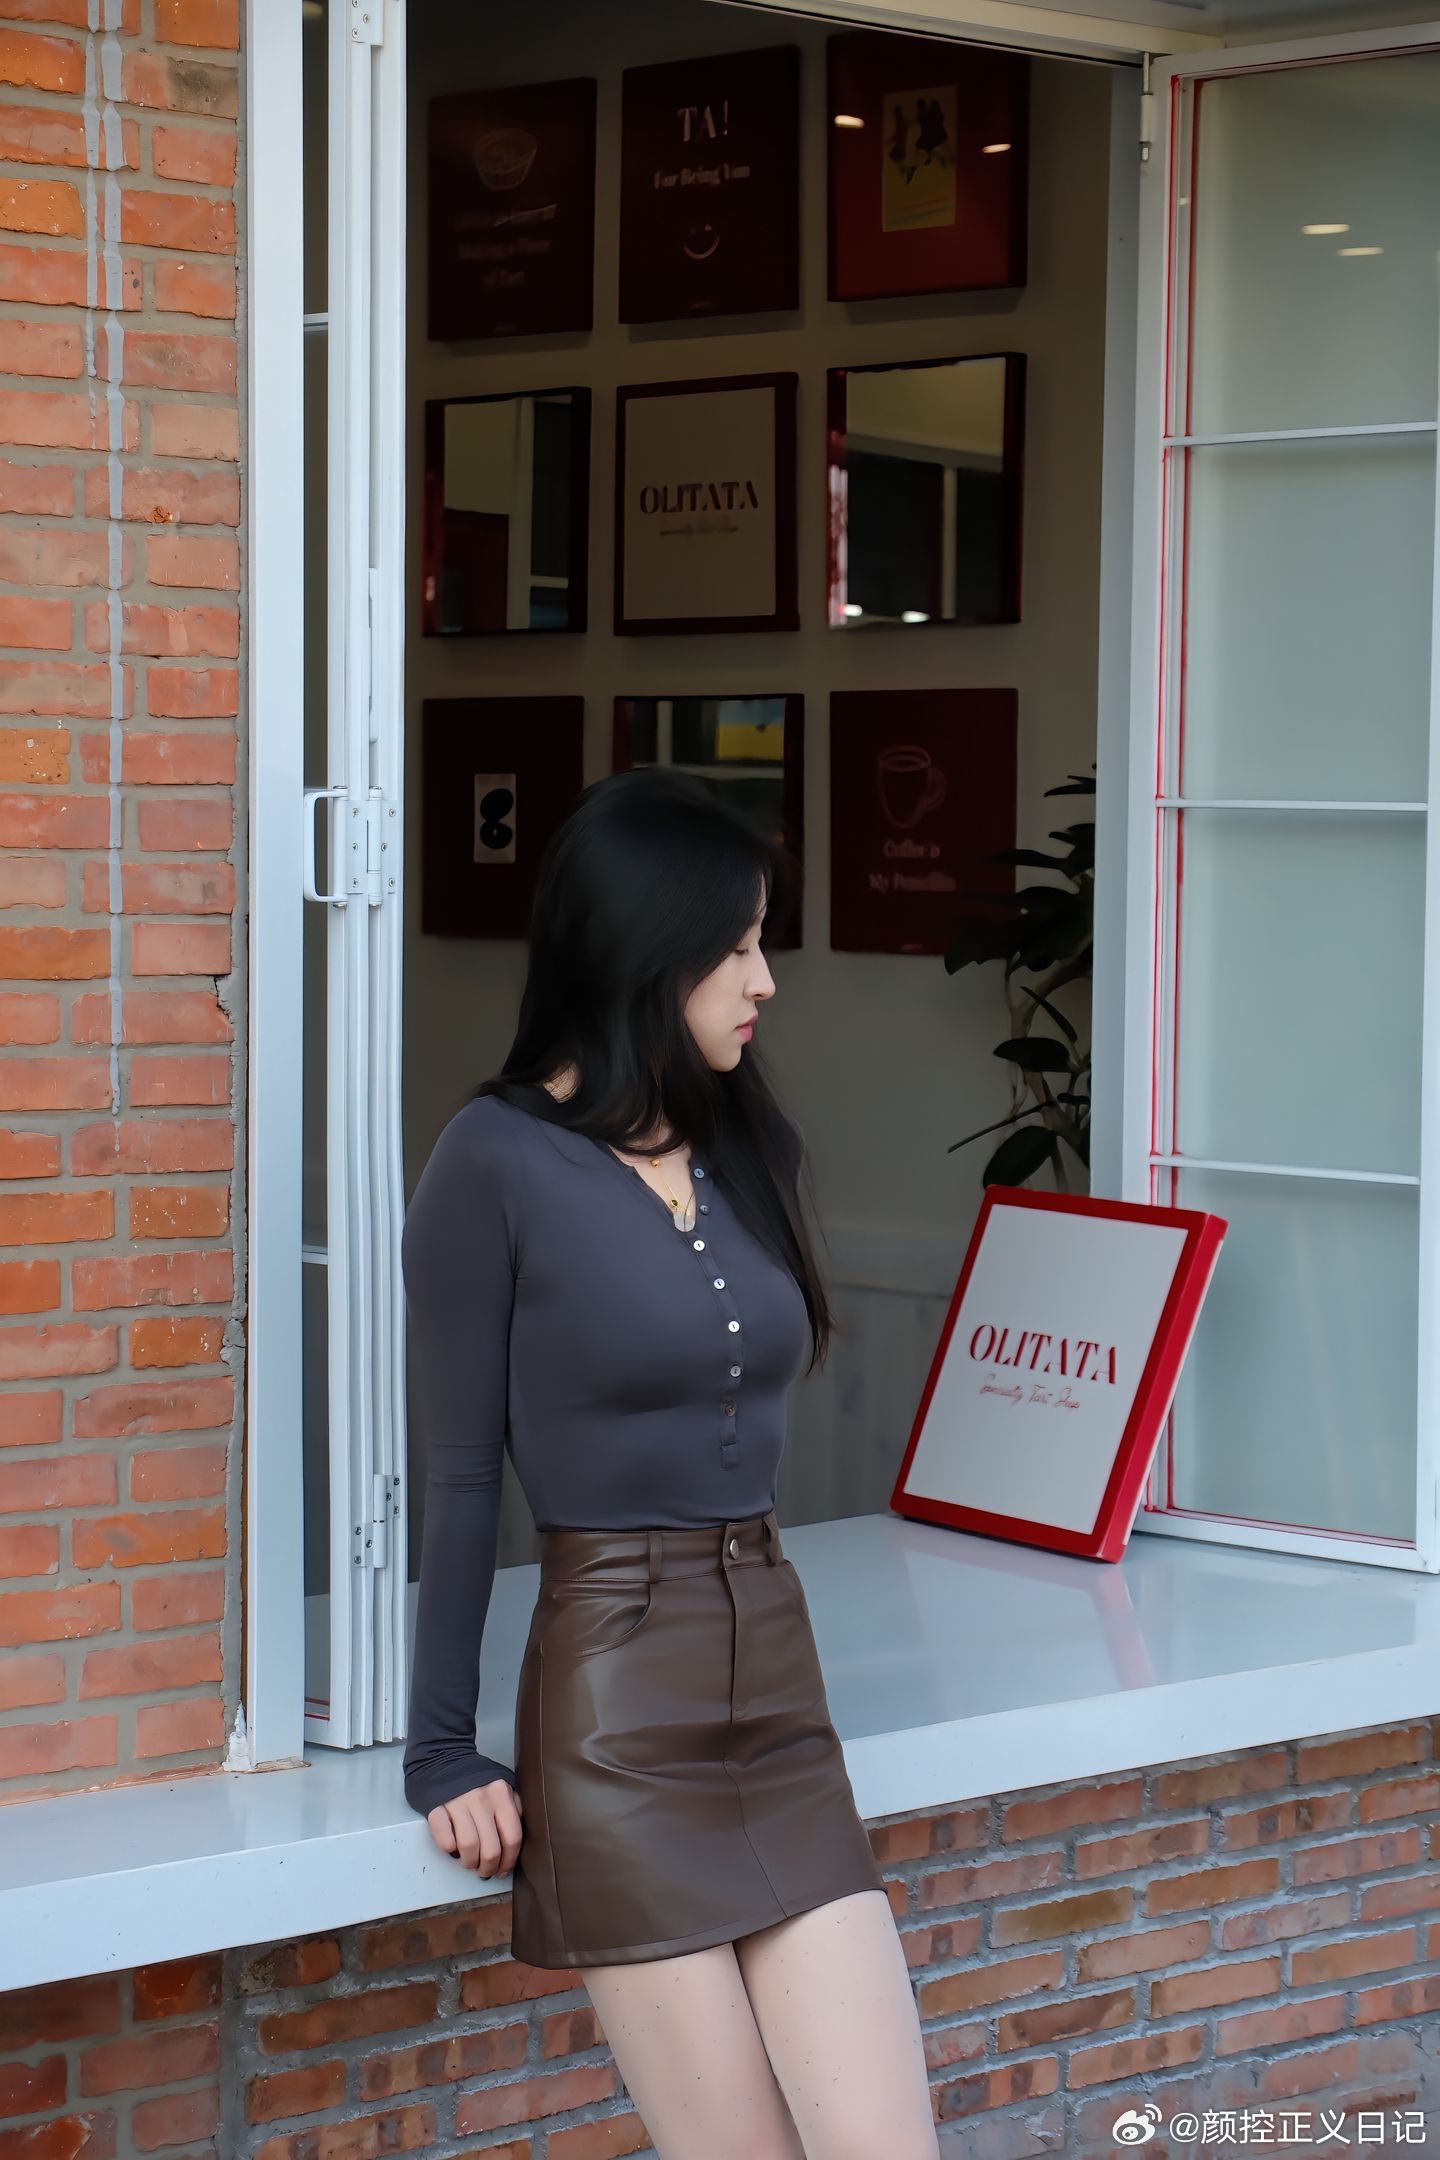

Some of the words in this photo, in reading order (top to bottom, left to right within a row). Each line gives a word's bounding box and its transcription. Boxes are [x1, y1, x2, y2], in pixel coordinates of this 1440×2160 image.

[675, 98, 730, 142] TA!
[639, 480, 759, 514] OLITATA
[969, 1324, 1116, 1385] OLITATA
